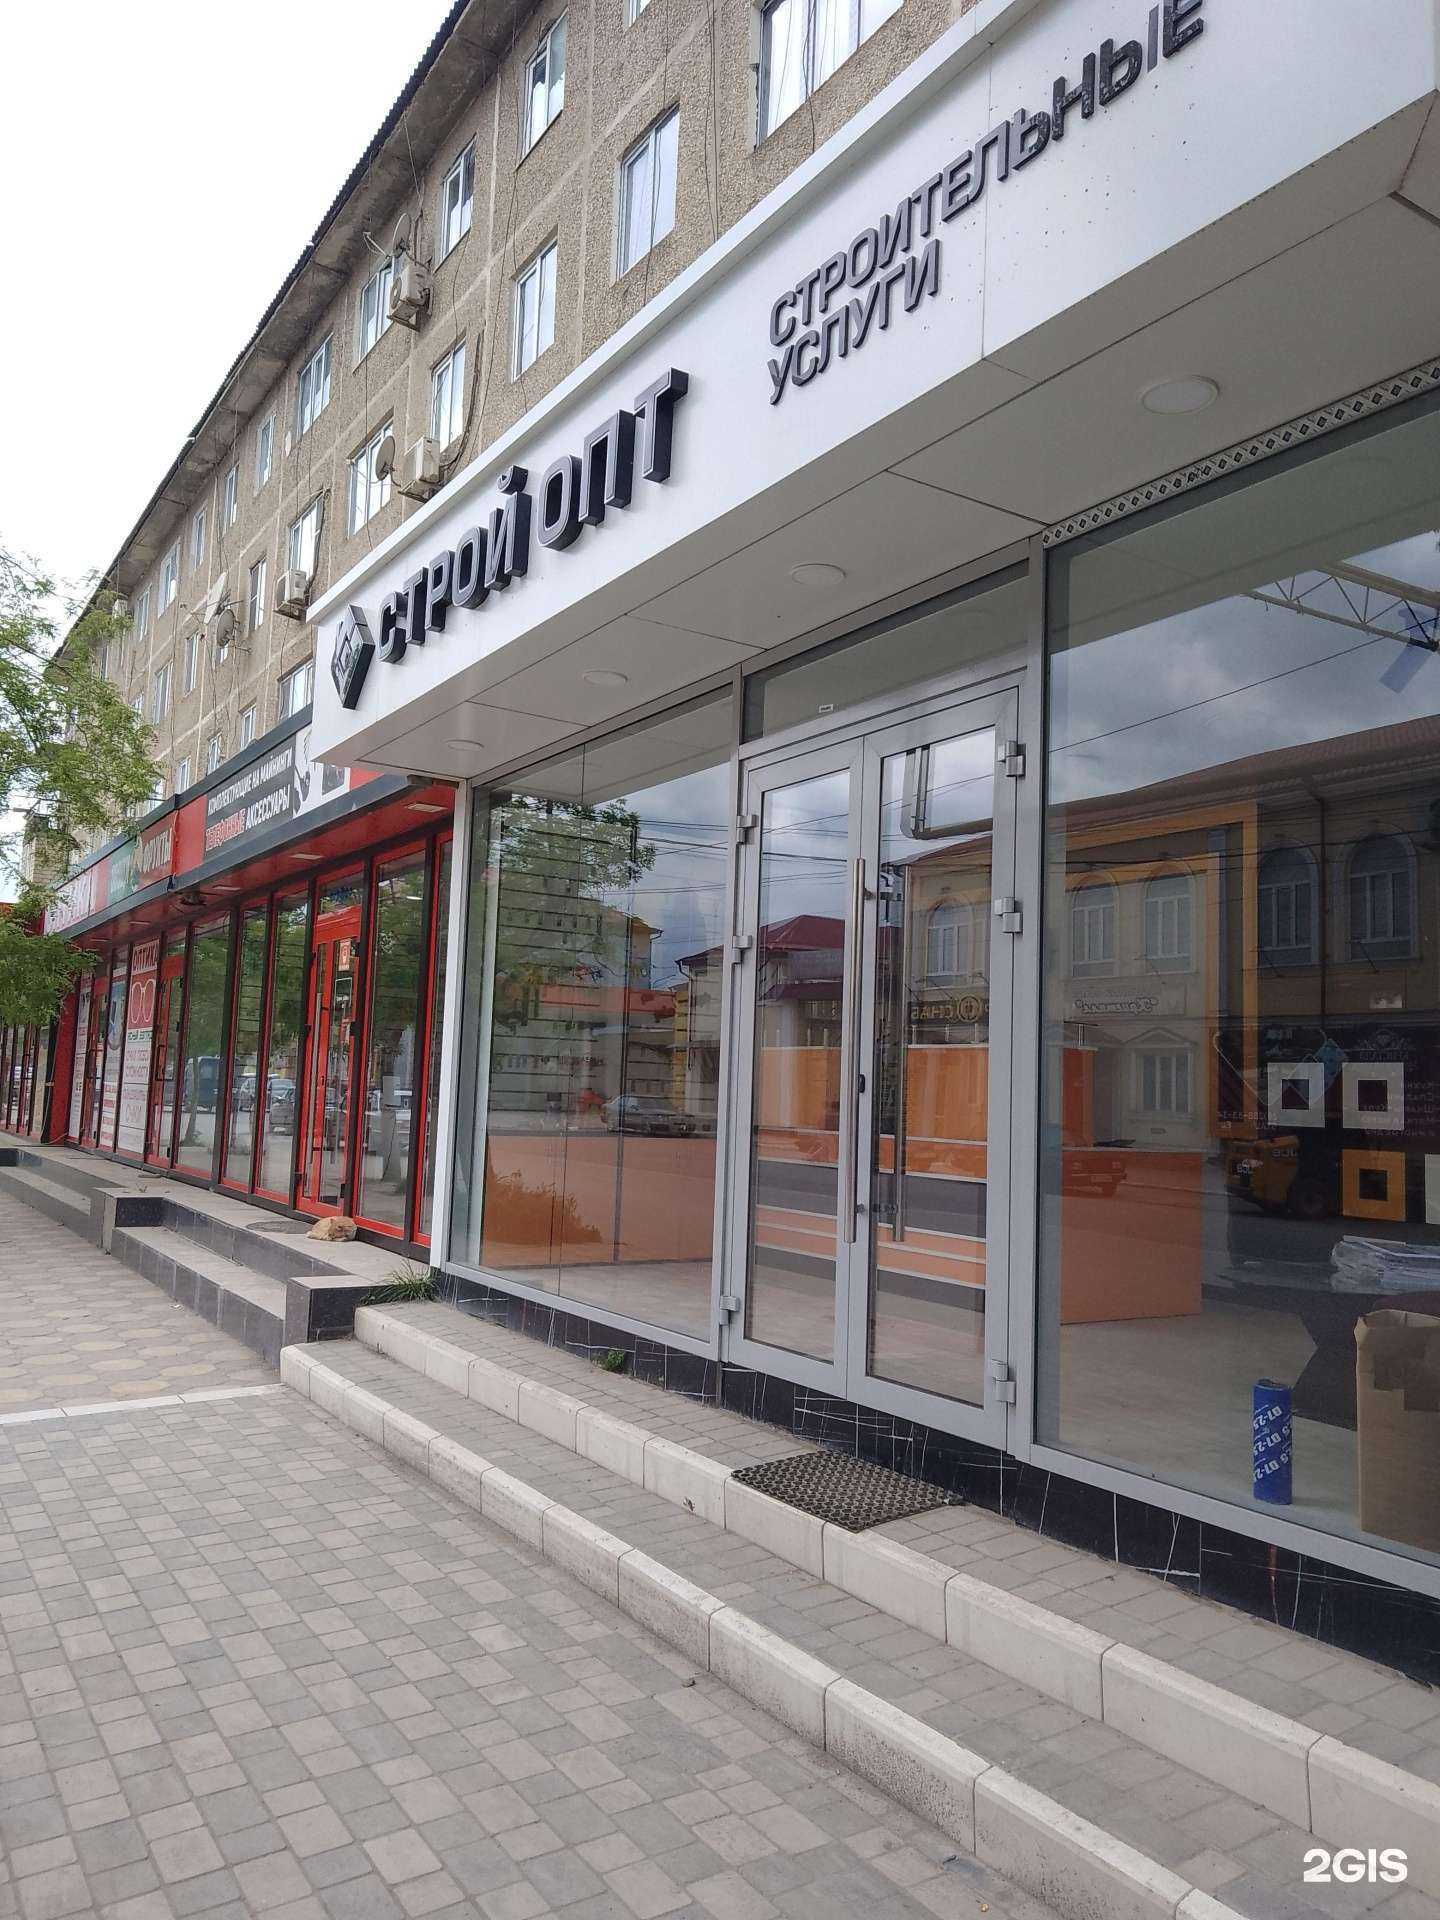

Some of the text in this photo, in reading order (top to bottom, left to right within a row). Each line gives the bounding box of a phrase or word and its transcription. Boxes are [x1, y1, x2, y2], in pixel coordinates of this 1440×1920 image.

[769, 0, 1204, 347] СТРОИТЕЛЬНЫЕ
[767, 239, 942, 405] УСЛУГИ
[246, 784, 291, 830] АКСЕССУАРЫ
